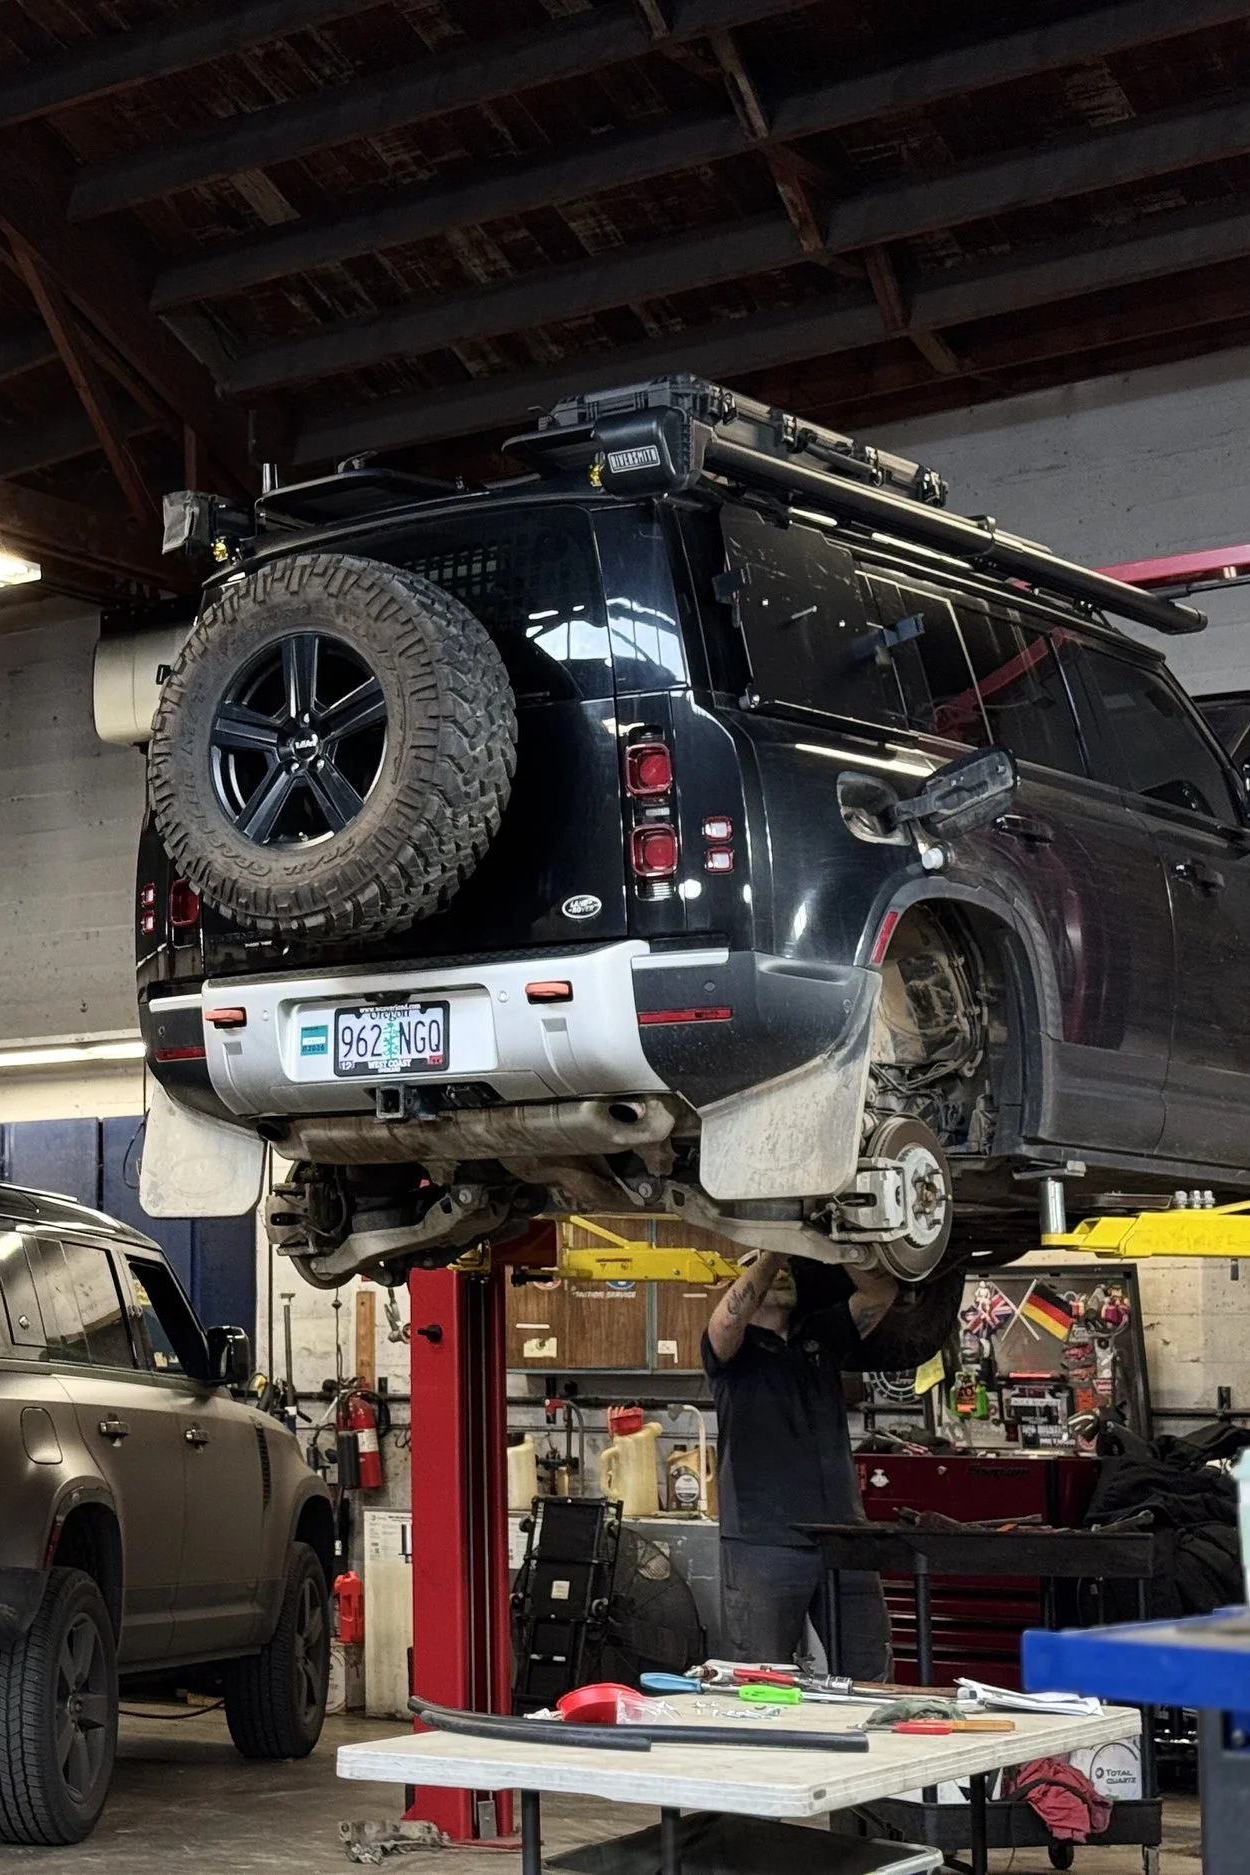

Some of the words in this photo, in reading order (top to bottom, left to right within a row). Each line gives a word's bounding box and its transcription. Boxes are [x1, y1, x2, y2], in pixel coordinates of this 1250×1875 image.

[610, 448, 657, 468] RIVERSMITH
[370, 1009, 410, 1021] Oregon
[341, 1024, 383, 1058] 962
[399, 1019, 441, 1055] NGQ
